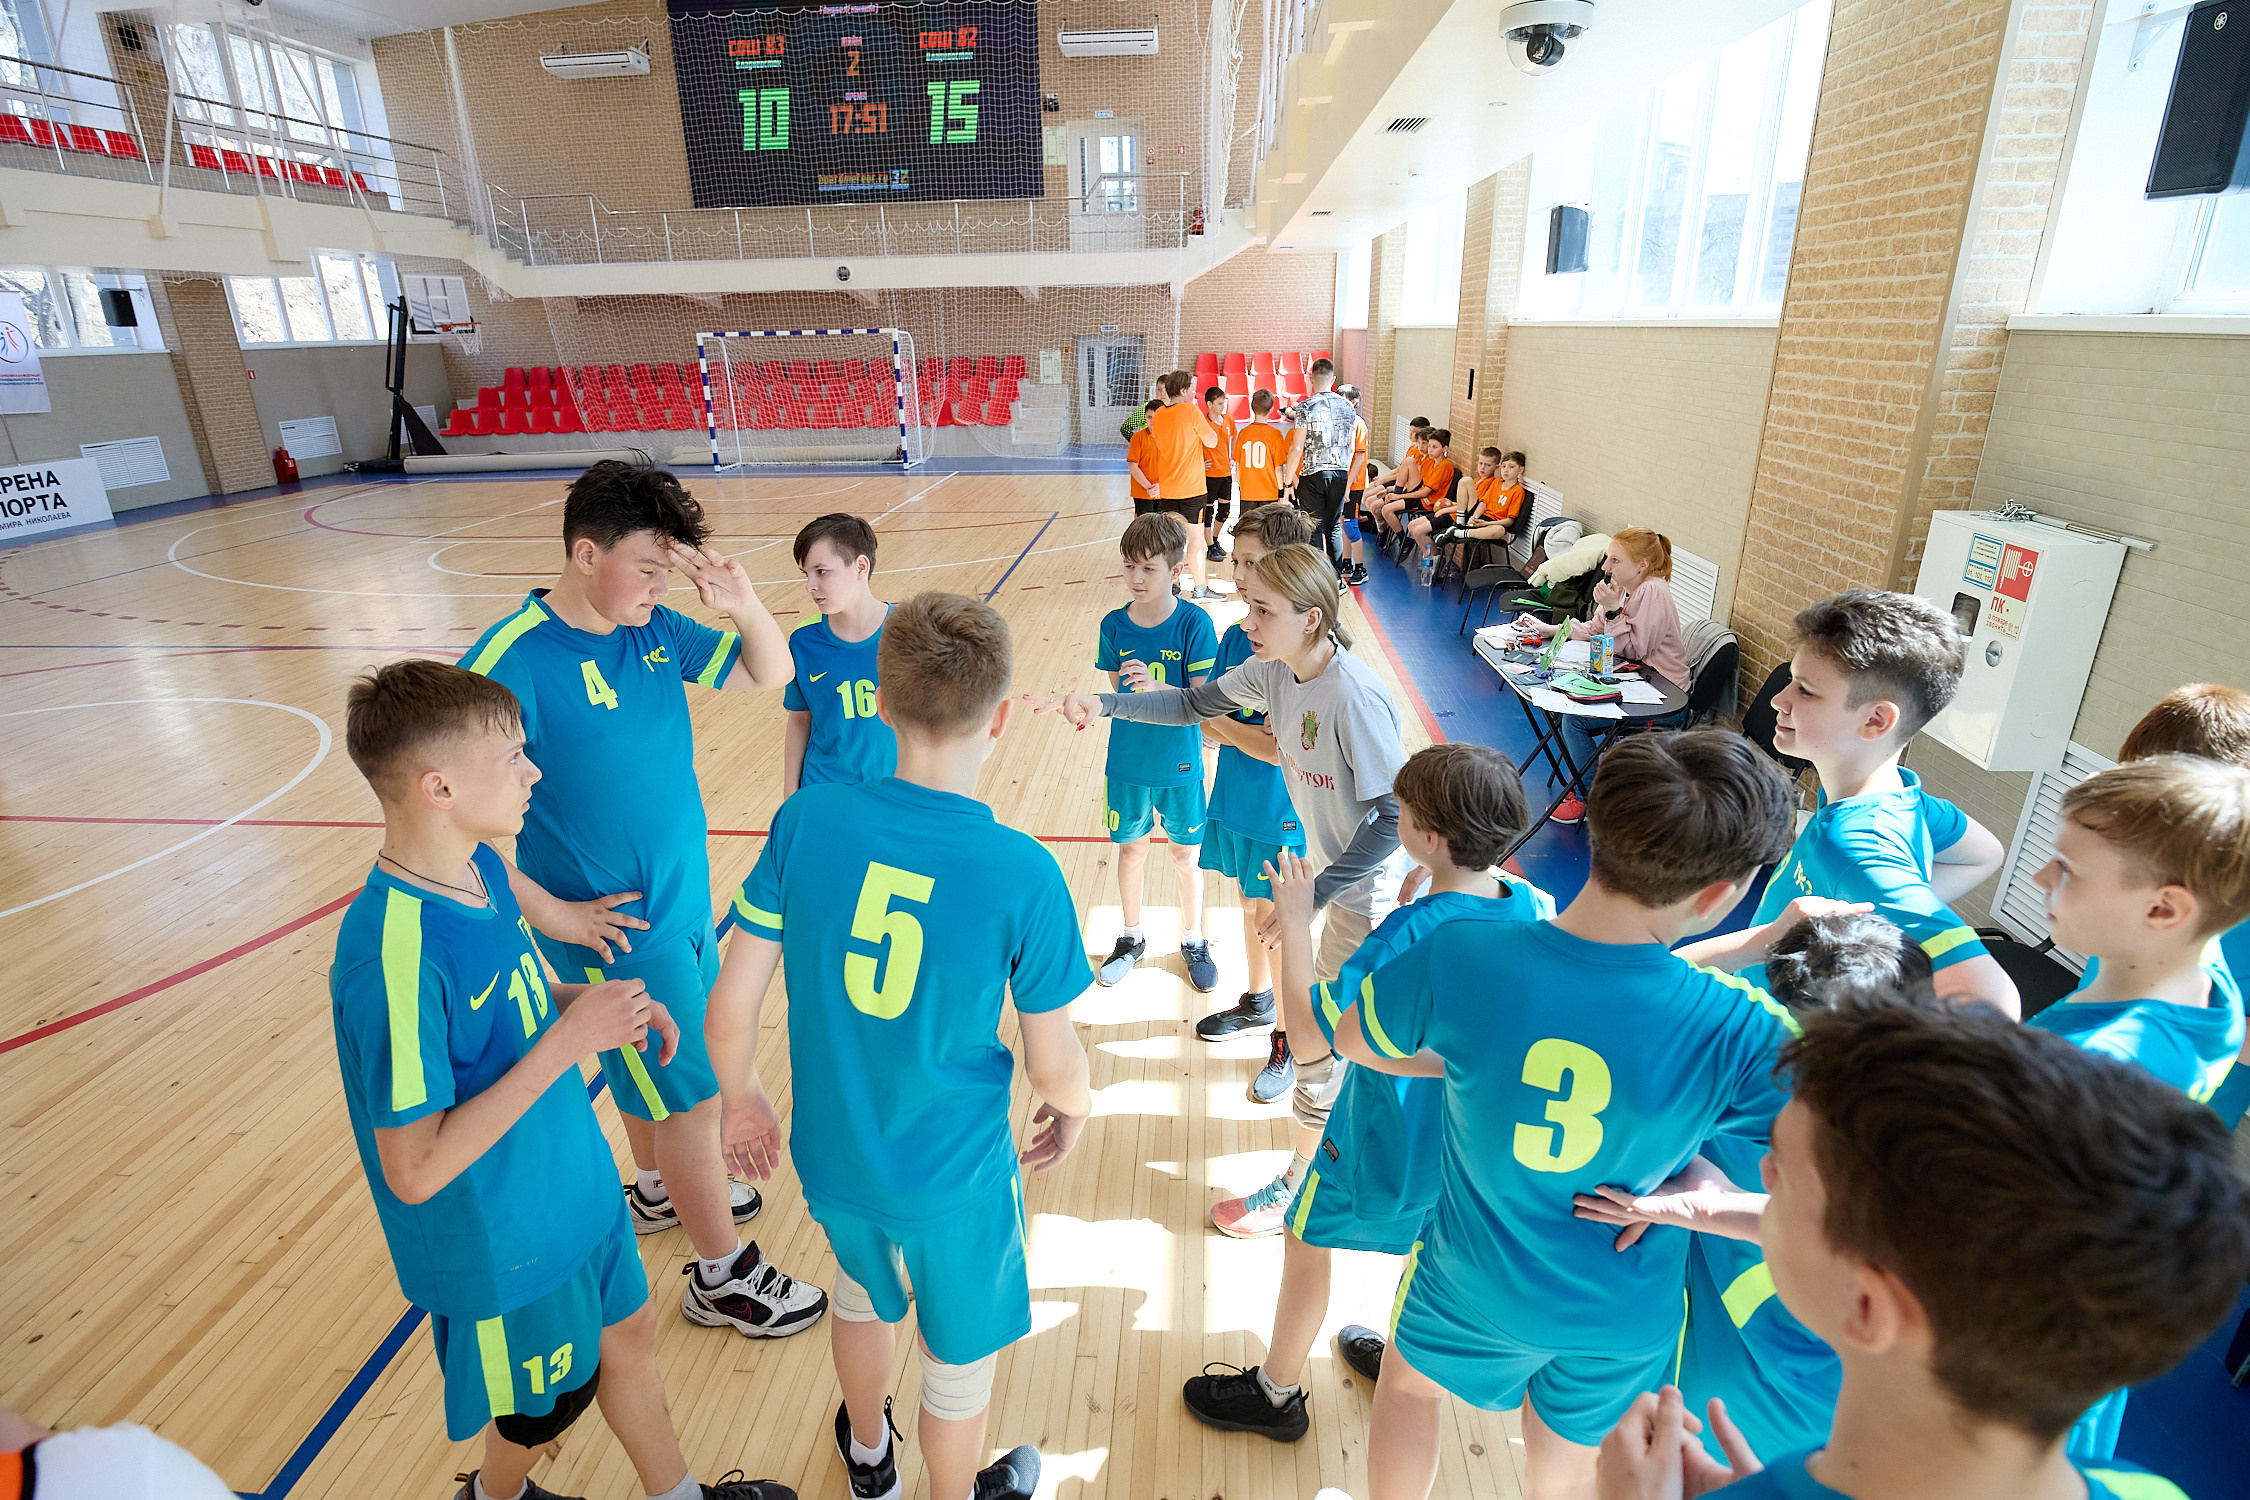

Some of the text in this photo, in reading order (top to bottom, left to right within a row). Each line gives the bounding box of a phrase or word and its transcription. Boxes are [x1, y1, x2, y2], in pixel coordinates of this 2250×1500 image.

[846, 51, 860, 76] 2
[739, 88, 789, 150] 10
[830, 103, 887, 134] 17:51
[927, 80, 980, 144] 15
[1242, 440, 1266, 469] 10
[0, 470, 61, 494] РЕНА
[26, 511, 72, 526] НИКОЛАЕВА
[1160, 649, 1182, 661] T90
[580, 660, 619, 710] 4
[836, 679, 878, 719] 16
[844, 861, 936, 1020] 5
[507, 952, 548, 1039] 13
[1513, 1038, 1612, 1173] 3
[522, 1342, 573, 1394] 13
